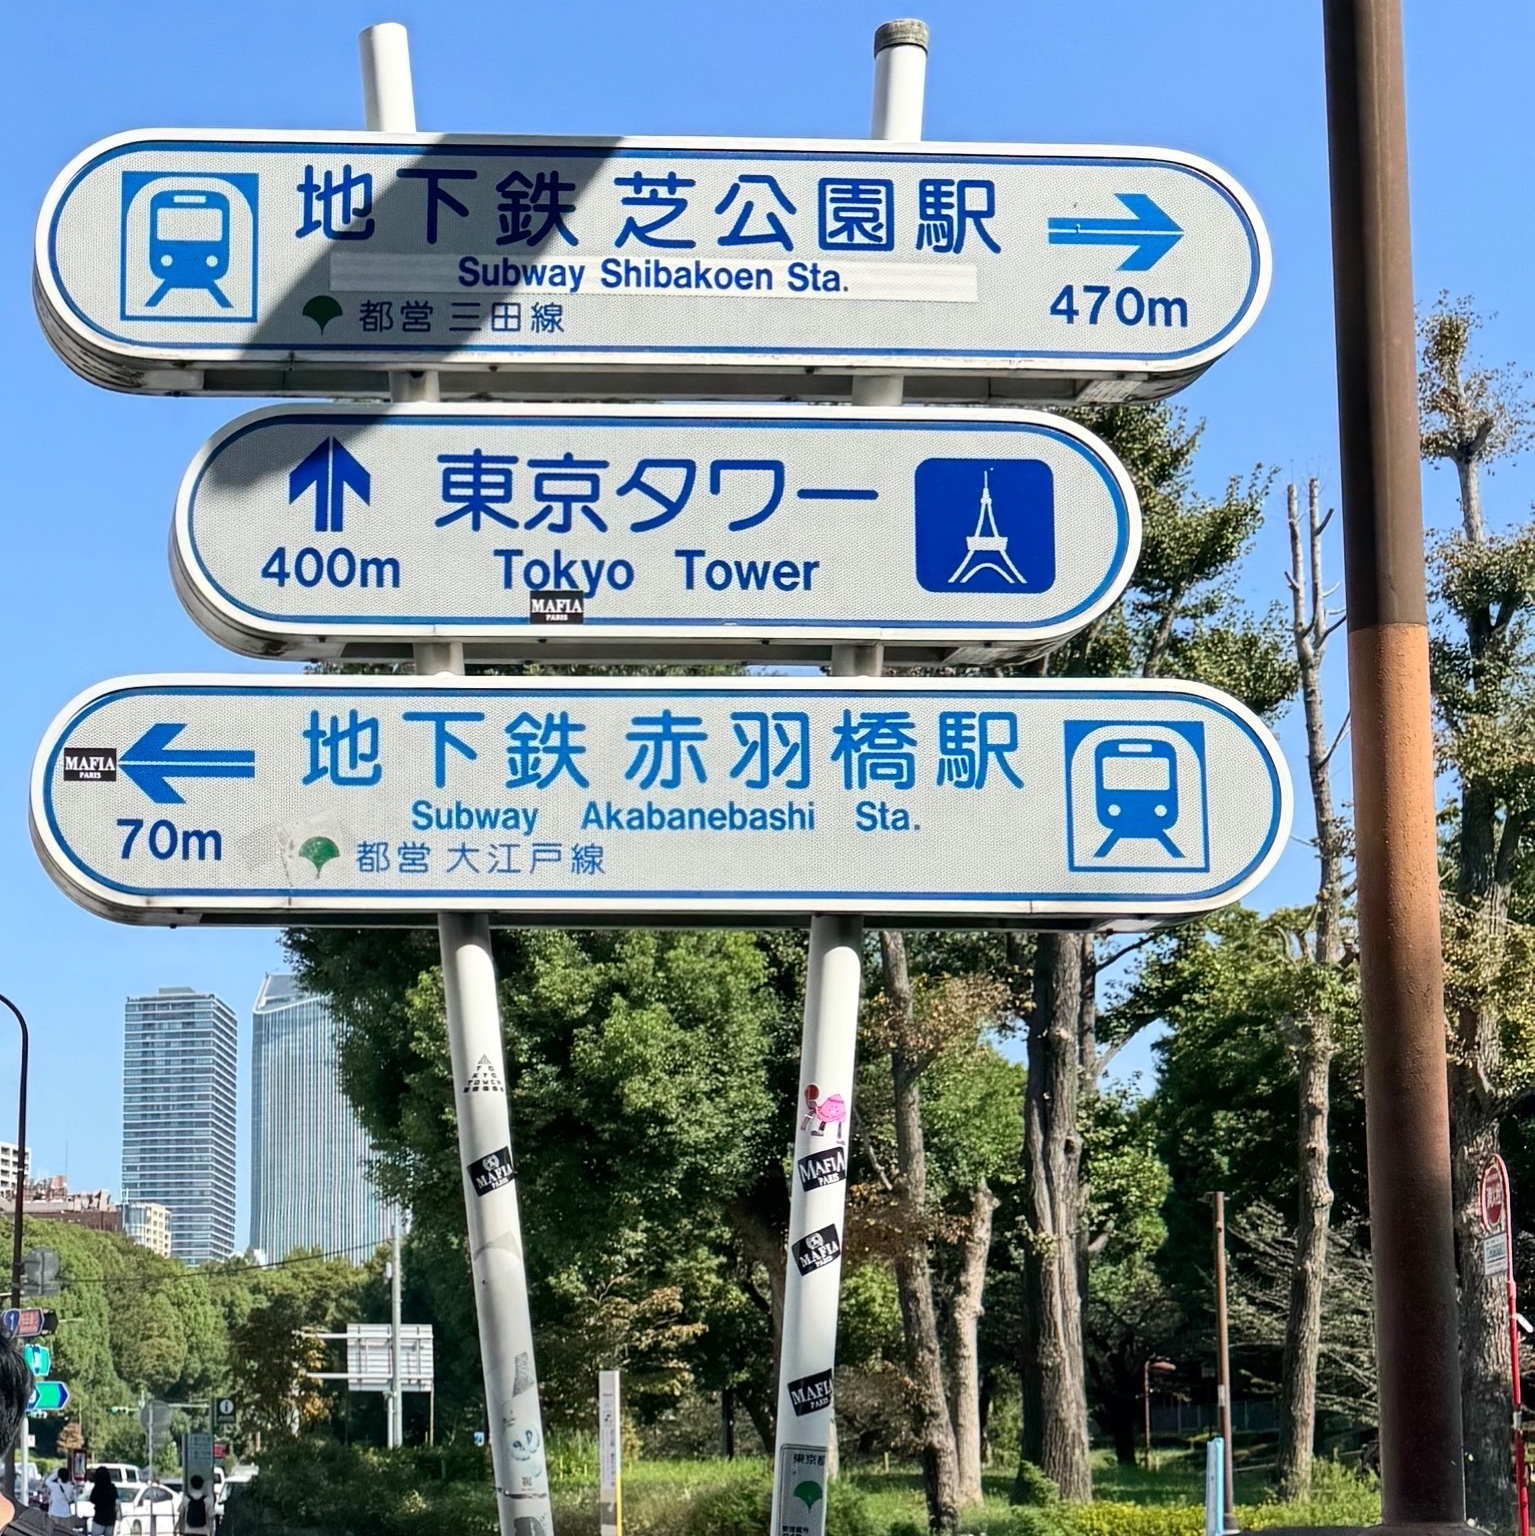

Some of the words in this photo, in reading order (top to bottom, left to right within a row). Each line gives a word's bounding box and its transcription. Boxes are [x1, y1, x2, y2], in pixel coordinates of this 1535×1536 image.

[458, 257, 586, 294] Subway
[600, 259, 773, 292] Shibakoen
[788, 262, 850, 293] Sta.
[1049, 285, 1188, 328] 470m
[434, 448, 879, 533] 東京タワー
[261, 547, 401, 588] 400m
[493, 549, 635, 599] Tokyo
[685, 549, 819, 592] Tower
[531, 599, 582, 613] MAFIA
[65, 756, 116, 771] MAFIA
[411, 800, 539, 833] Subway
[581, 800, 816, 832] Akabanebashi
[855, 800, 921, 833] Sta.
[116, 818, 223, 861] 70m
[476, 1163, 513, 1190] MAFIA
[799, 1151, 845, 1183] MAFIA
[799, 1241, 839, 1268] MAFIA
